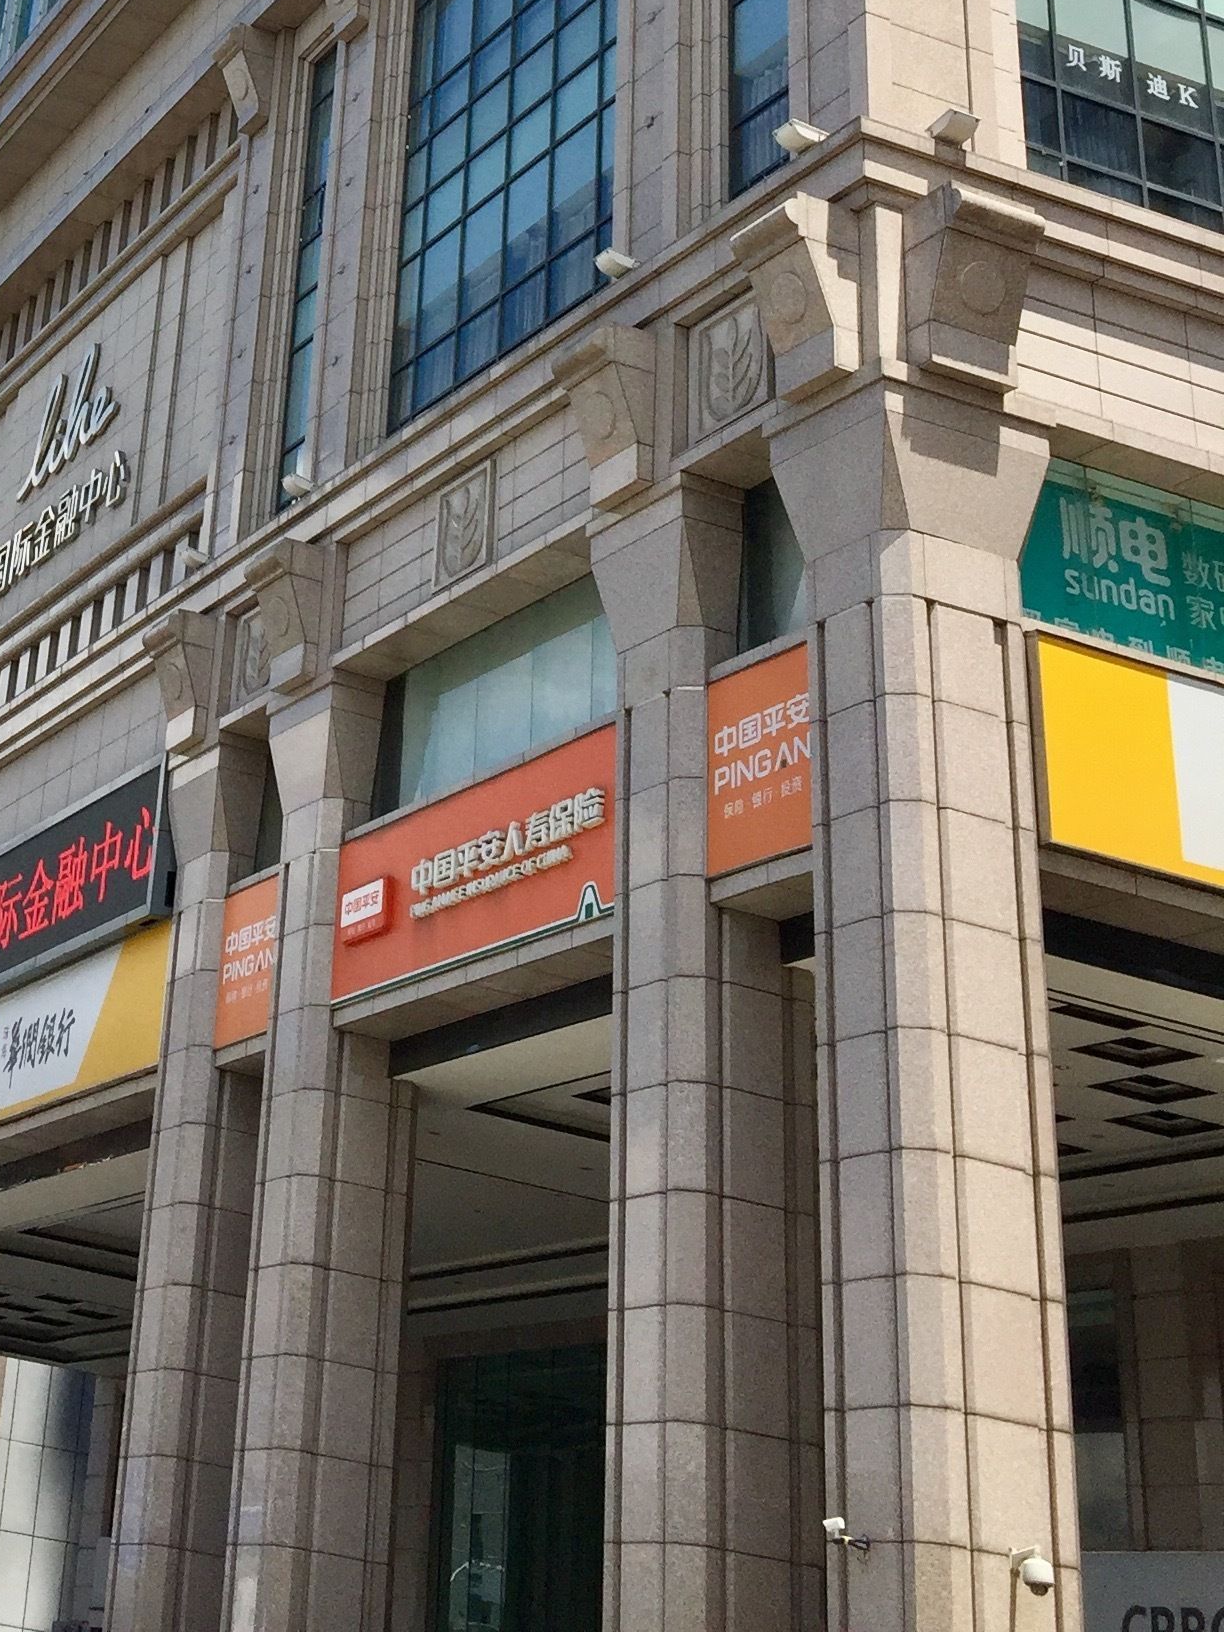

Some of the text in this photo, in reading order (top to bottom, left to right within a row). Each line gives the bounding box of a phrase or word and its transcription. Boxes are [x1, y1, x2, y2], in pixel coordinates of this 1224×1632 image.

[1059, 496, 1172, 588] 顺电
[1064, 568, 1176, 621] sundan
[1185, 593, 1224, 631] 家
[714, 692, 810, 757] 中国平安
[411, 787, 605, 895] 中国平安人寿保险
